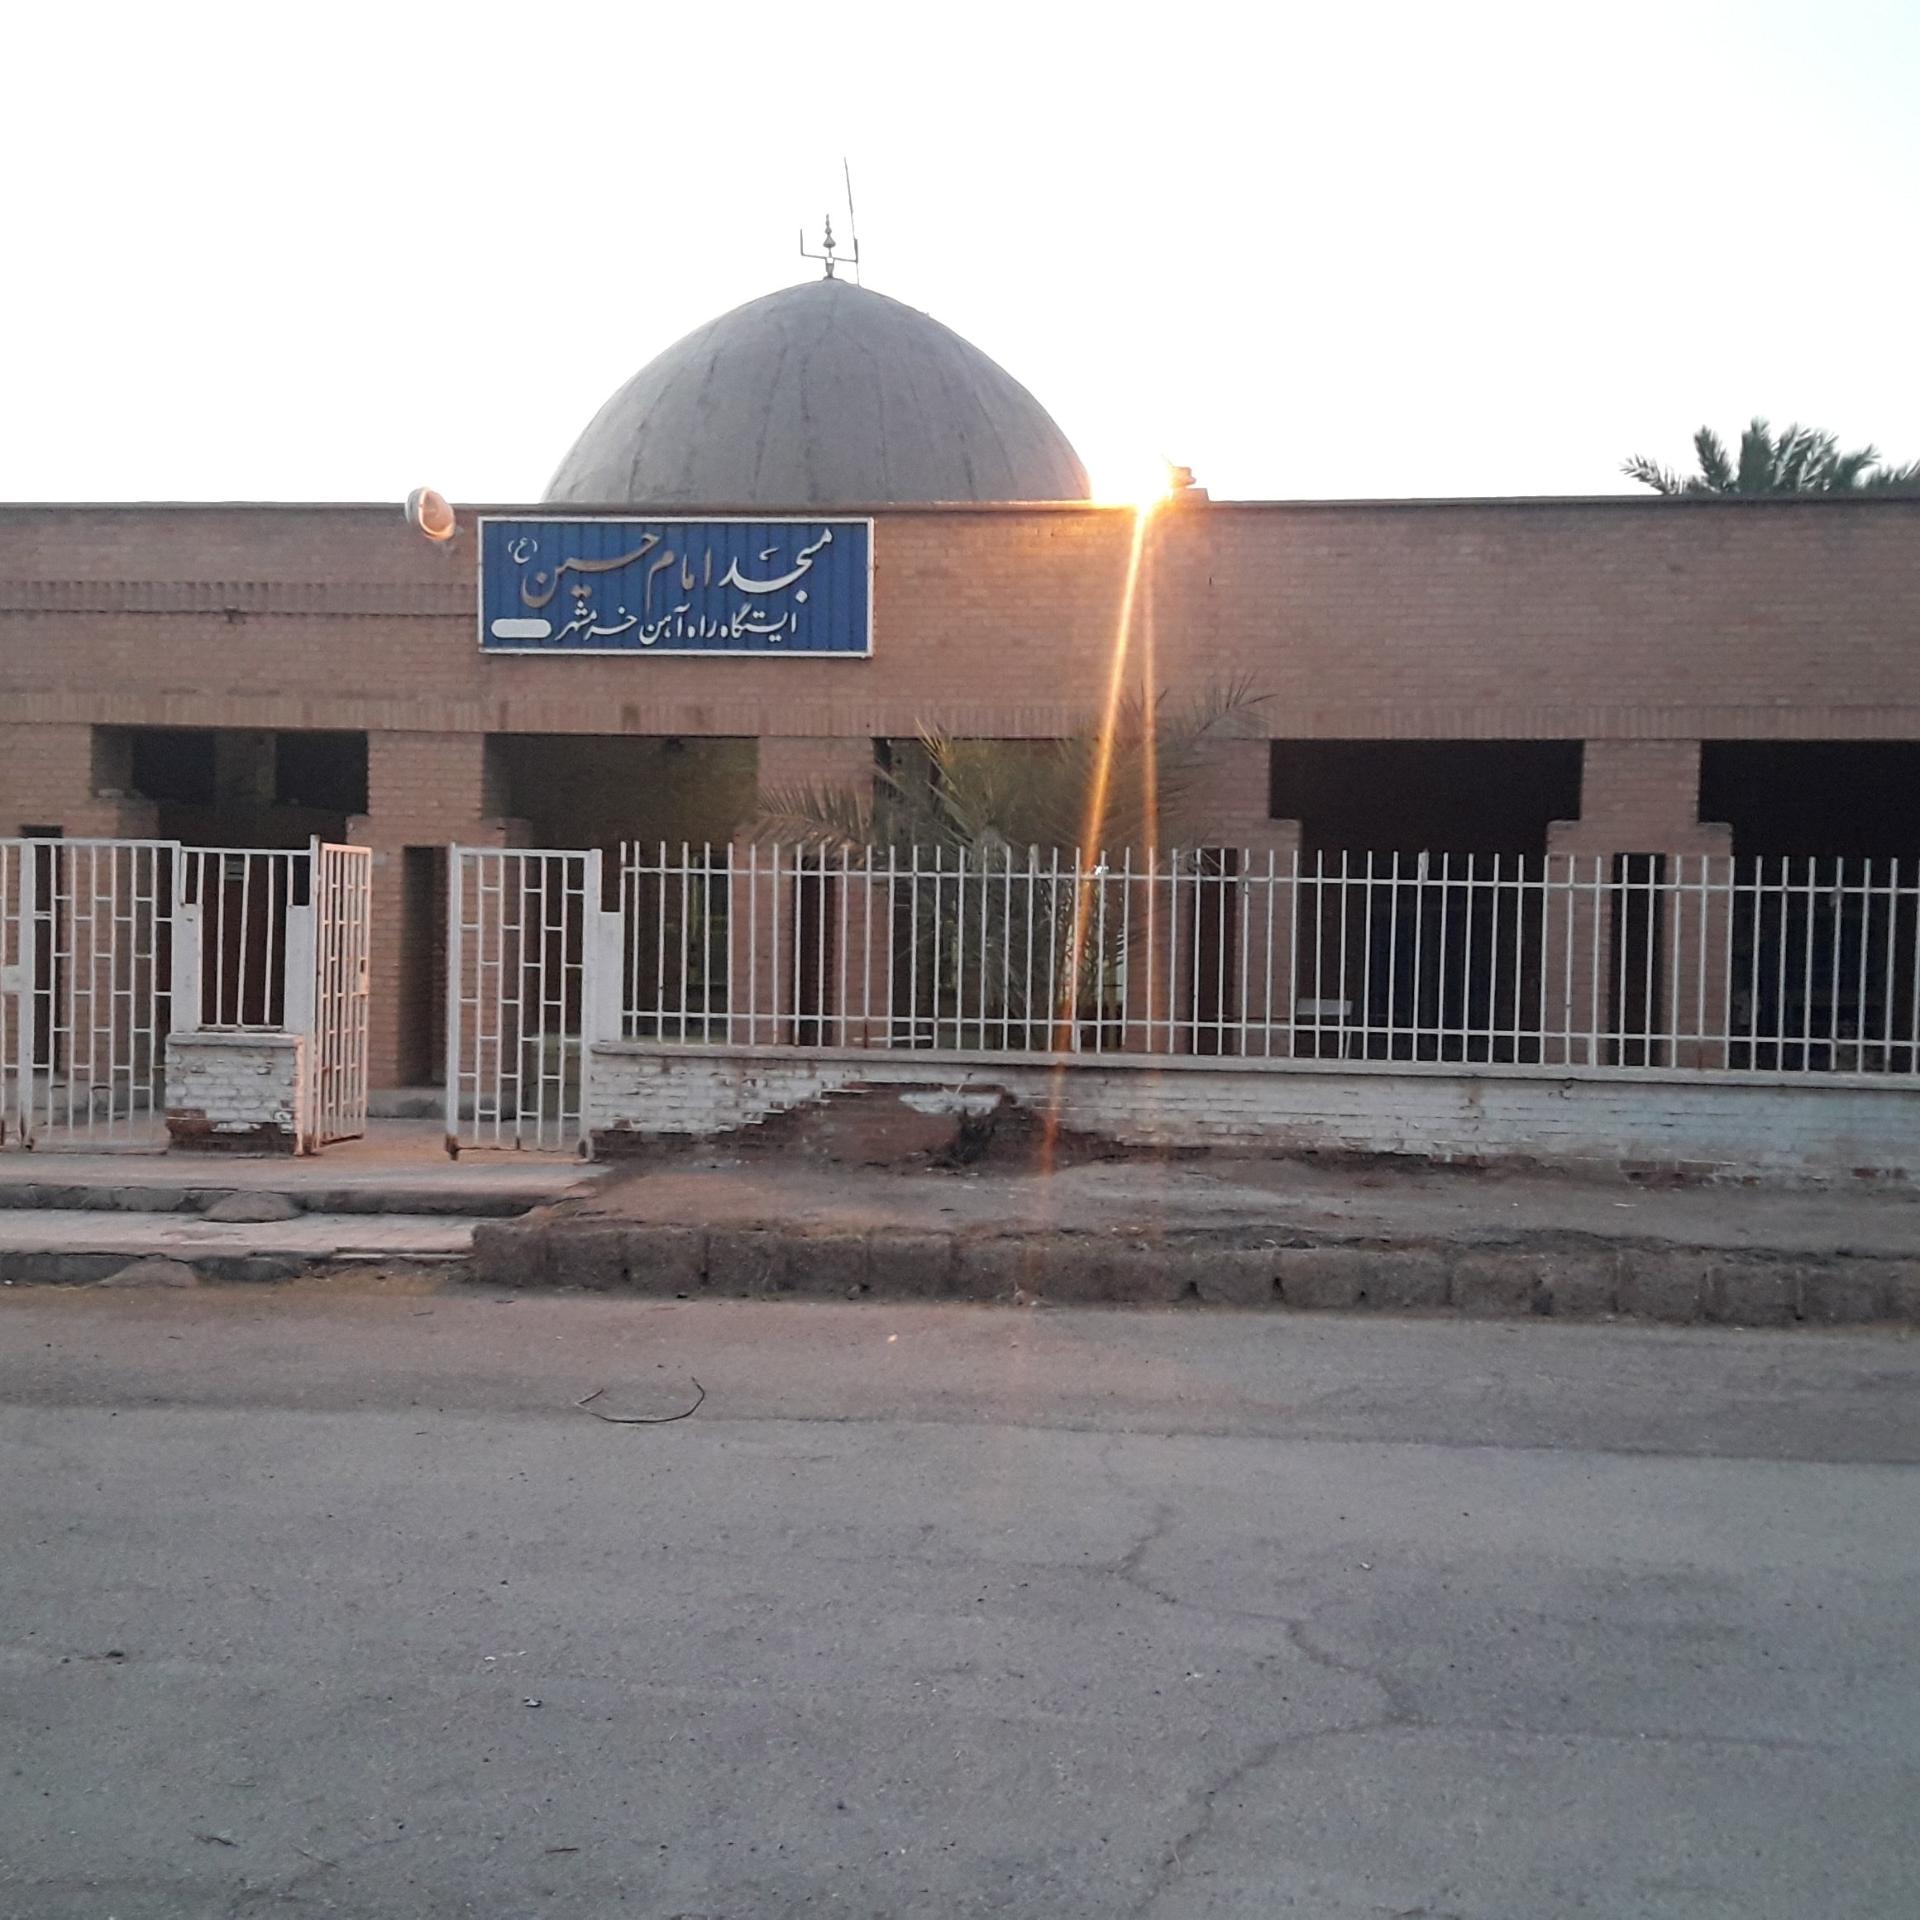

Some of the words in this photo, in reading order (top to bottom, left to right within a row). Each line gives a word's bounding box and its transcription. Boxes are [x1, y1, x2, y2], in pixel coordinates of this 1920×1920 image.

[507, 536, 538, 564] (ع)
[521, 533, 662, 609] حسین
[718, 527, 833, 604] مسجد
[645, 547, 712, 617] امام
[554, 600, 638, 641] خرمشهر
[639, 602, 691, 645] آهن
[687, 614, 718, 638] راه
[720, 602, 797, 642] ایستگاه
